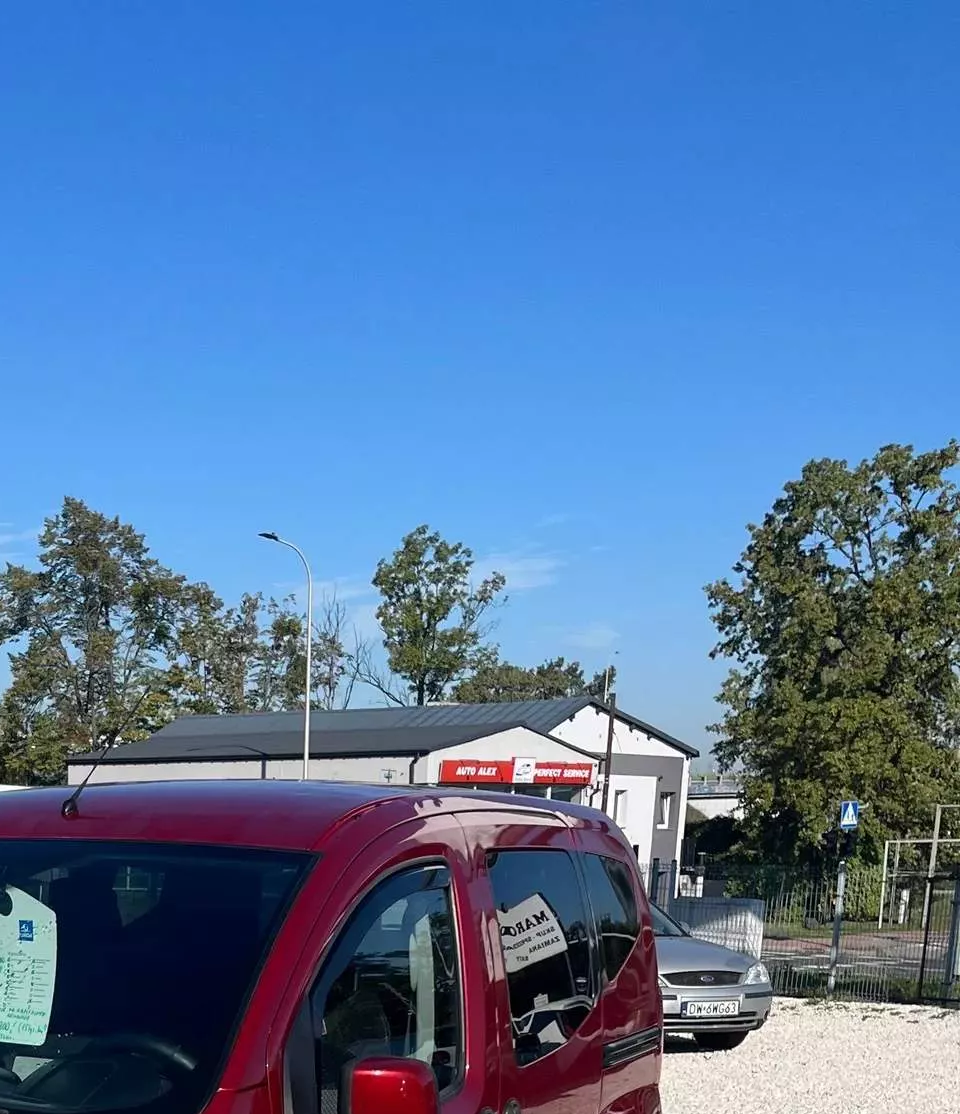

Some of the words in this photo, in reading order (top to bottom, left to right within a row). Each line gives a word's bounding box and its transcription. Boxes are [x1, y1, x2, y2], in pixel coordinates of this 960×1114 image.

[456, 766, 477, 776] AUTO
[478, 767, 498, 776] ALEX
[533, 768, 561, 777] PERFECT
[563, 769, 590, 778] SERVICE
[689, 1003, 703, 1014] DW
[706, 1002, 736, 1014] 6WG63
